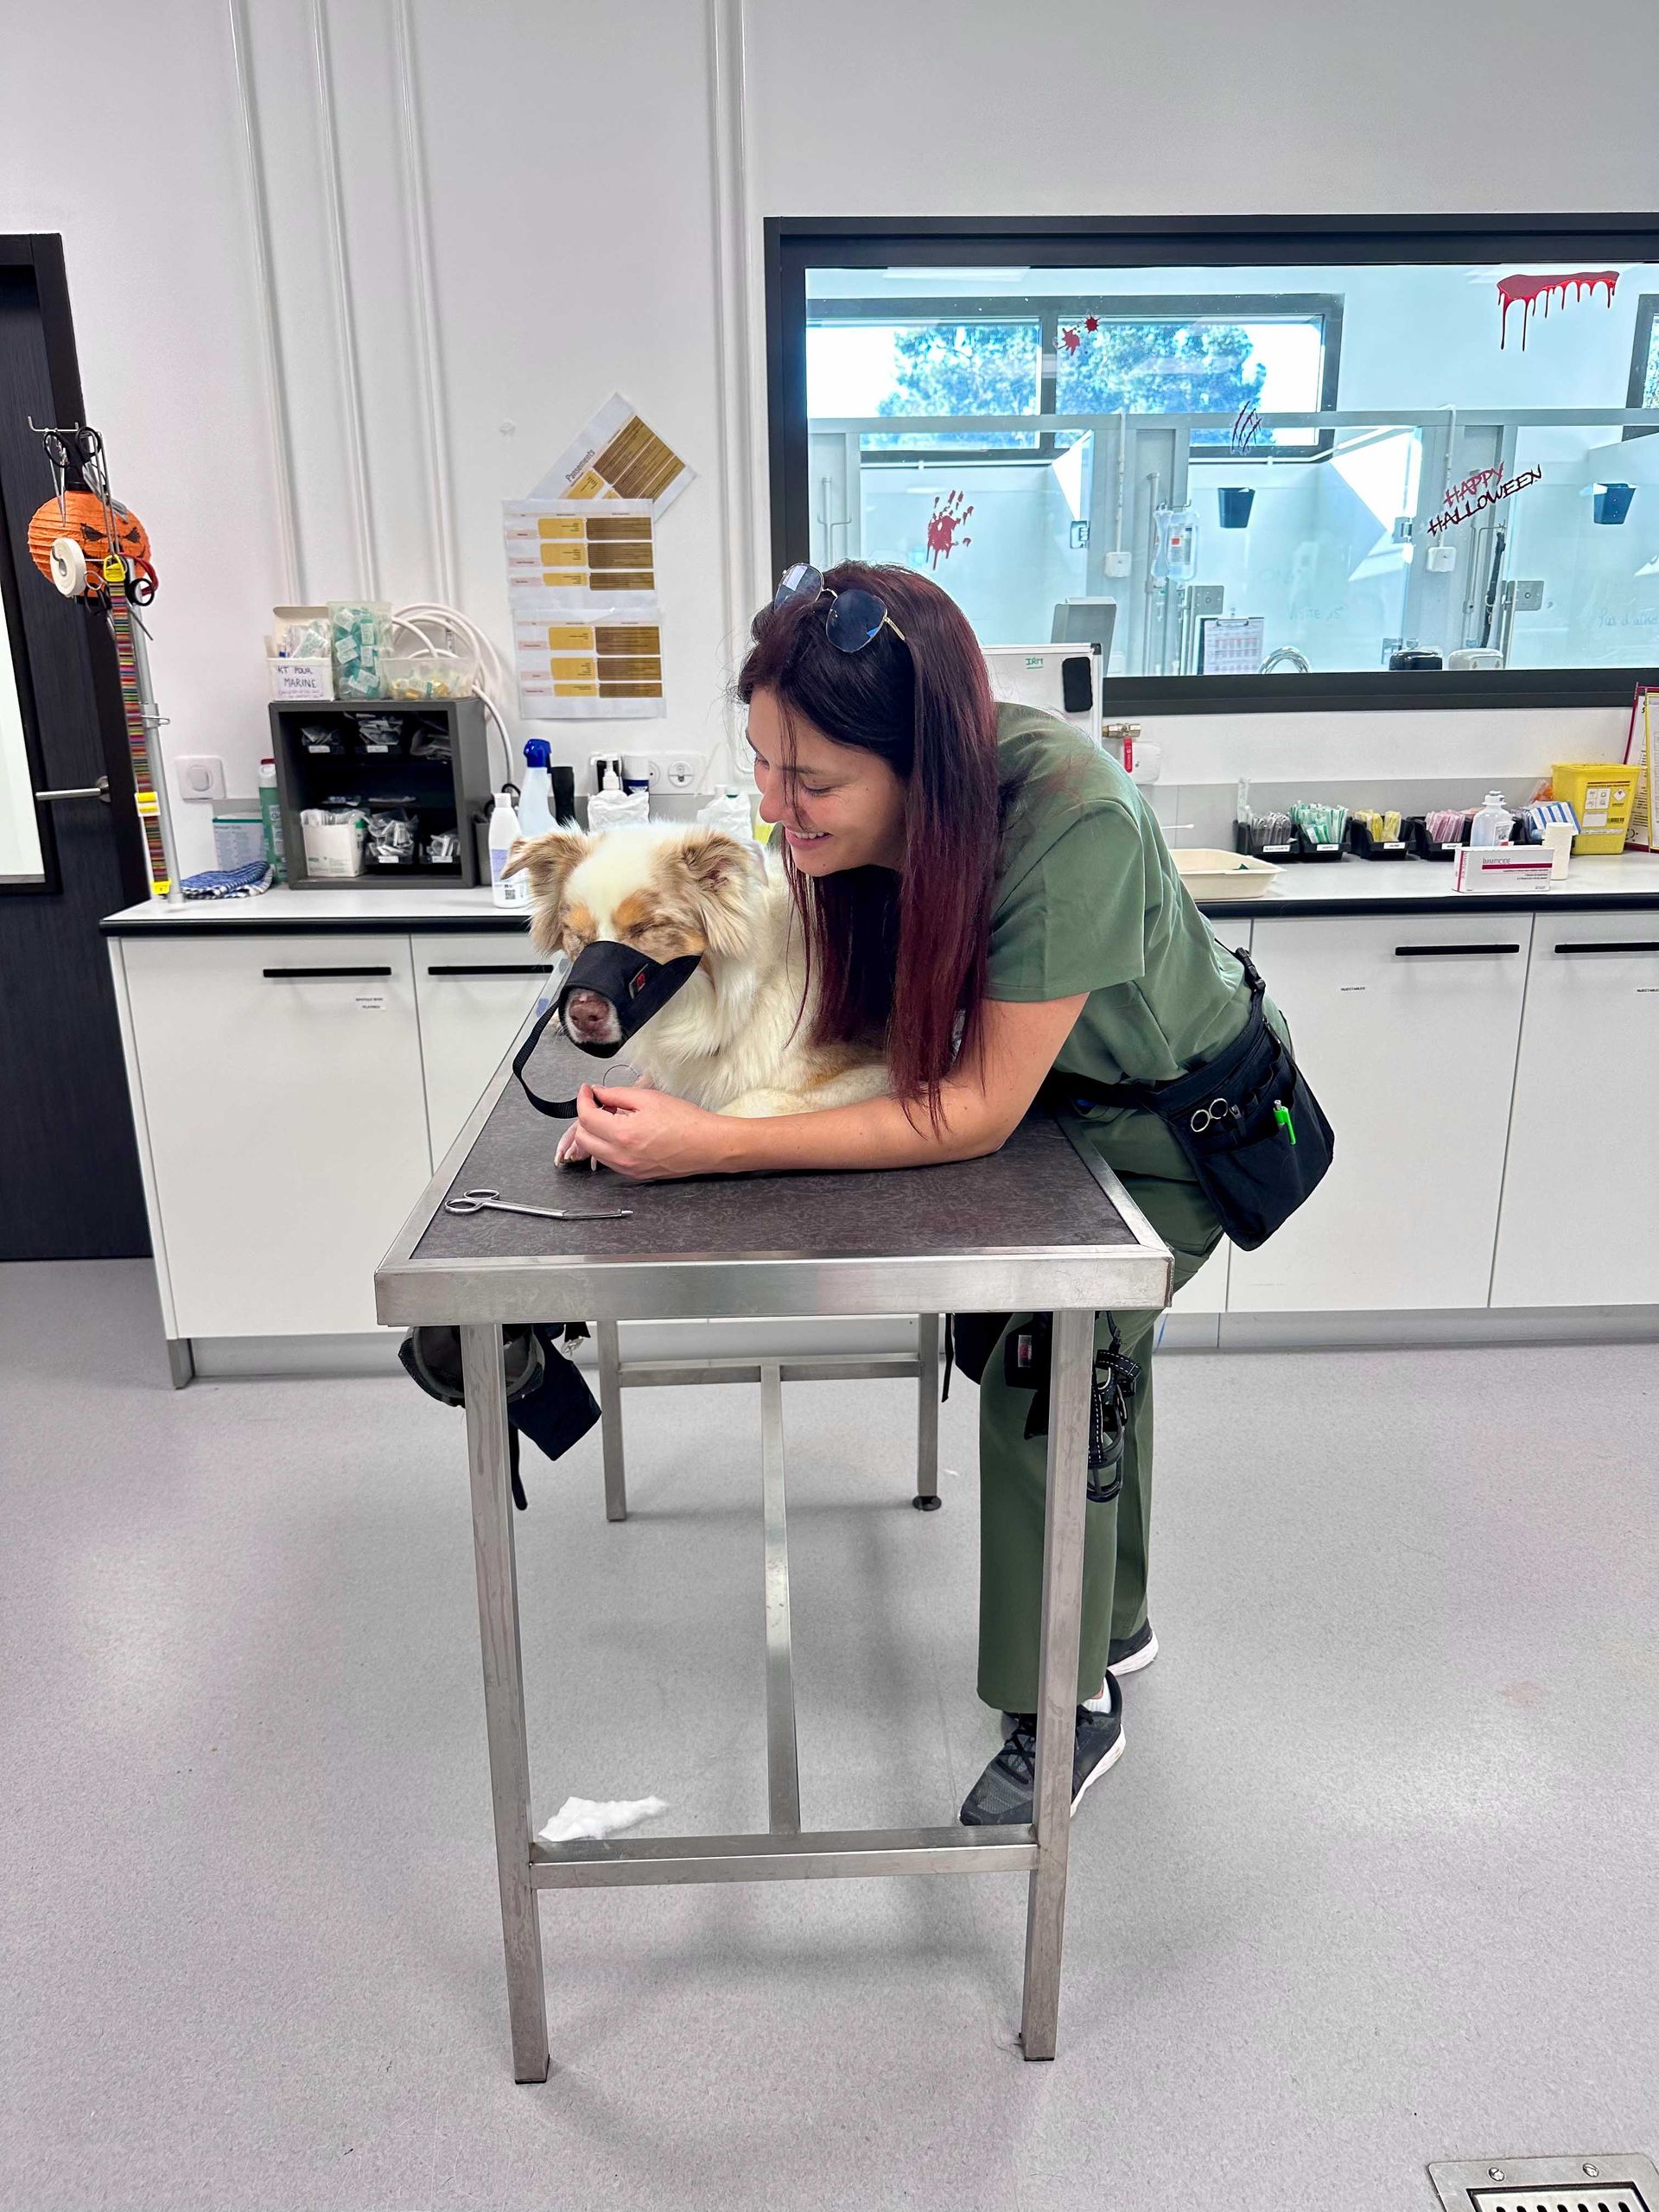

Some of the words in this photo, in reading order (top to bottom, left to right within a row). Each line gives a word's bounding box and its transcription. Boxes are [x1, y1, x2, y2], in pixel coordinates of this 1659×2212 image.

[565, 448, 595, 482] Pansements
[1427, 464, 1541, 537] HALLOWEEN
[1443, 461, 1503, 508] HAPPY
[283, 677, 317, 689] MARINE
[295, 665, 314, 674] POUR
